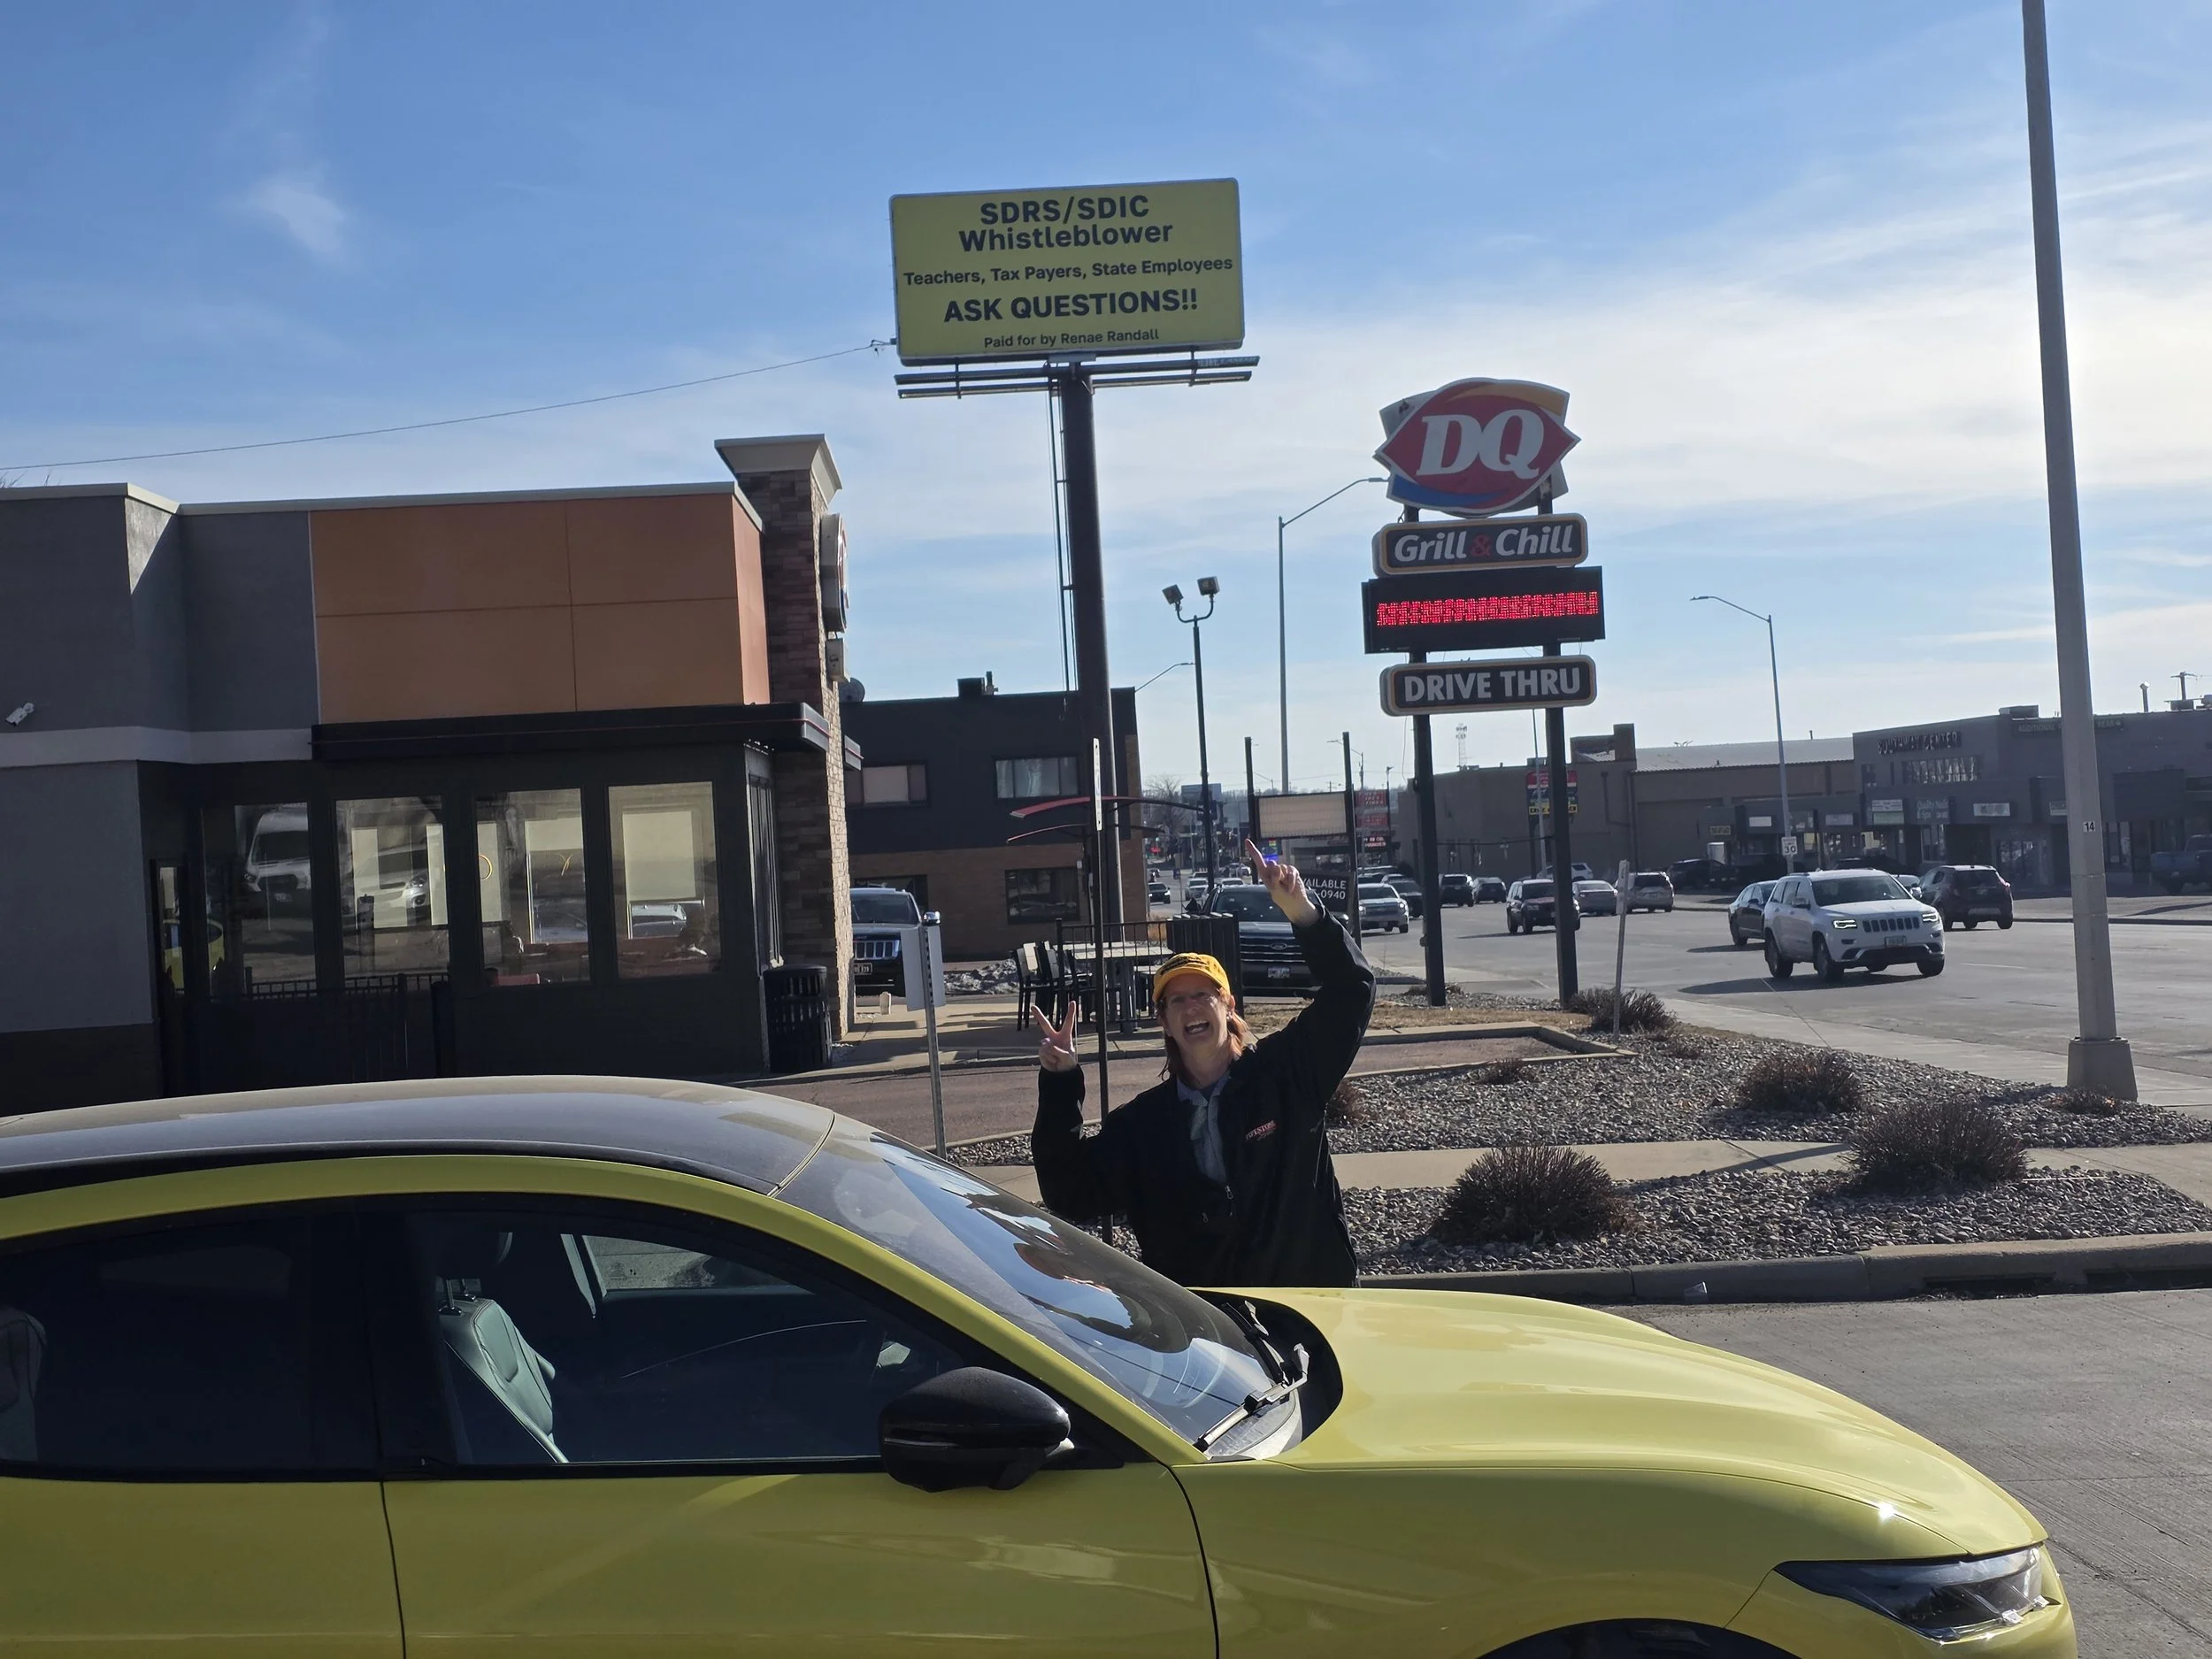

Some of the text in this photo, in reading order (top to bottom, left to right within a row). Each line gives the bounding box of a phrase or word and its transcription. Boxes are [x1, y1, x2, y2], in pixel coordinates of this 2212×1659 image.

[980, 195, 1149, 226] SDRS/SDIC
[958, 225, 1173, 253] Whistleblower
[903, 257, 1233, 287] Teachers, Tax Payers, State Employees
[944, 288, 1198, 323] ASK QUESTIONS!!
[984, 328, 1159, 349] Paid for by Renae Randall
[1416, 409, 1546, 480] DQ
[1394, 524, 1573, 563] Grill & Chill
[1403, 666, 1580, 703] DRIVE THRU
[2084, 821, 2095, 832] 14
